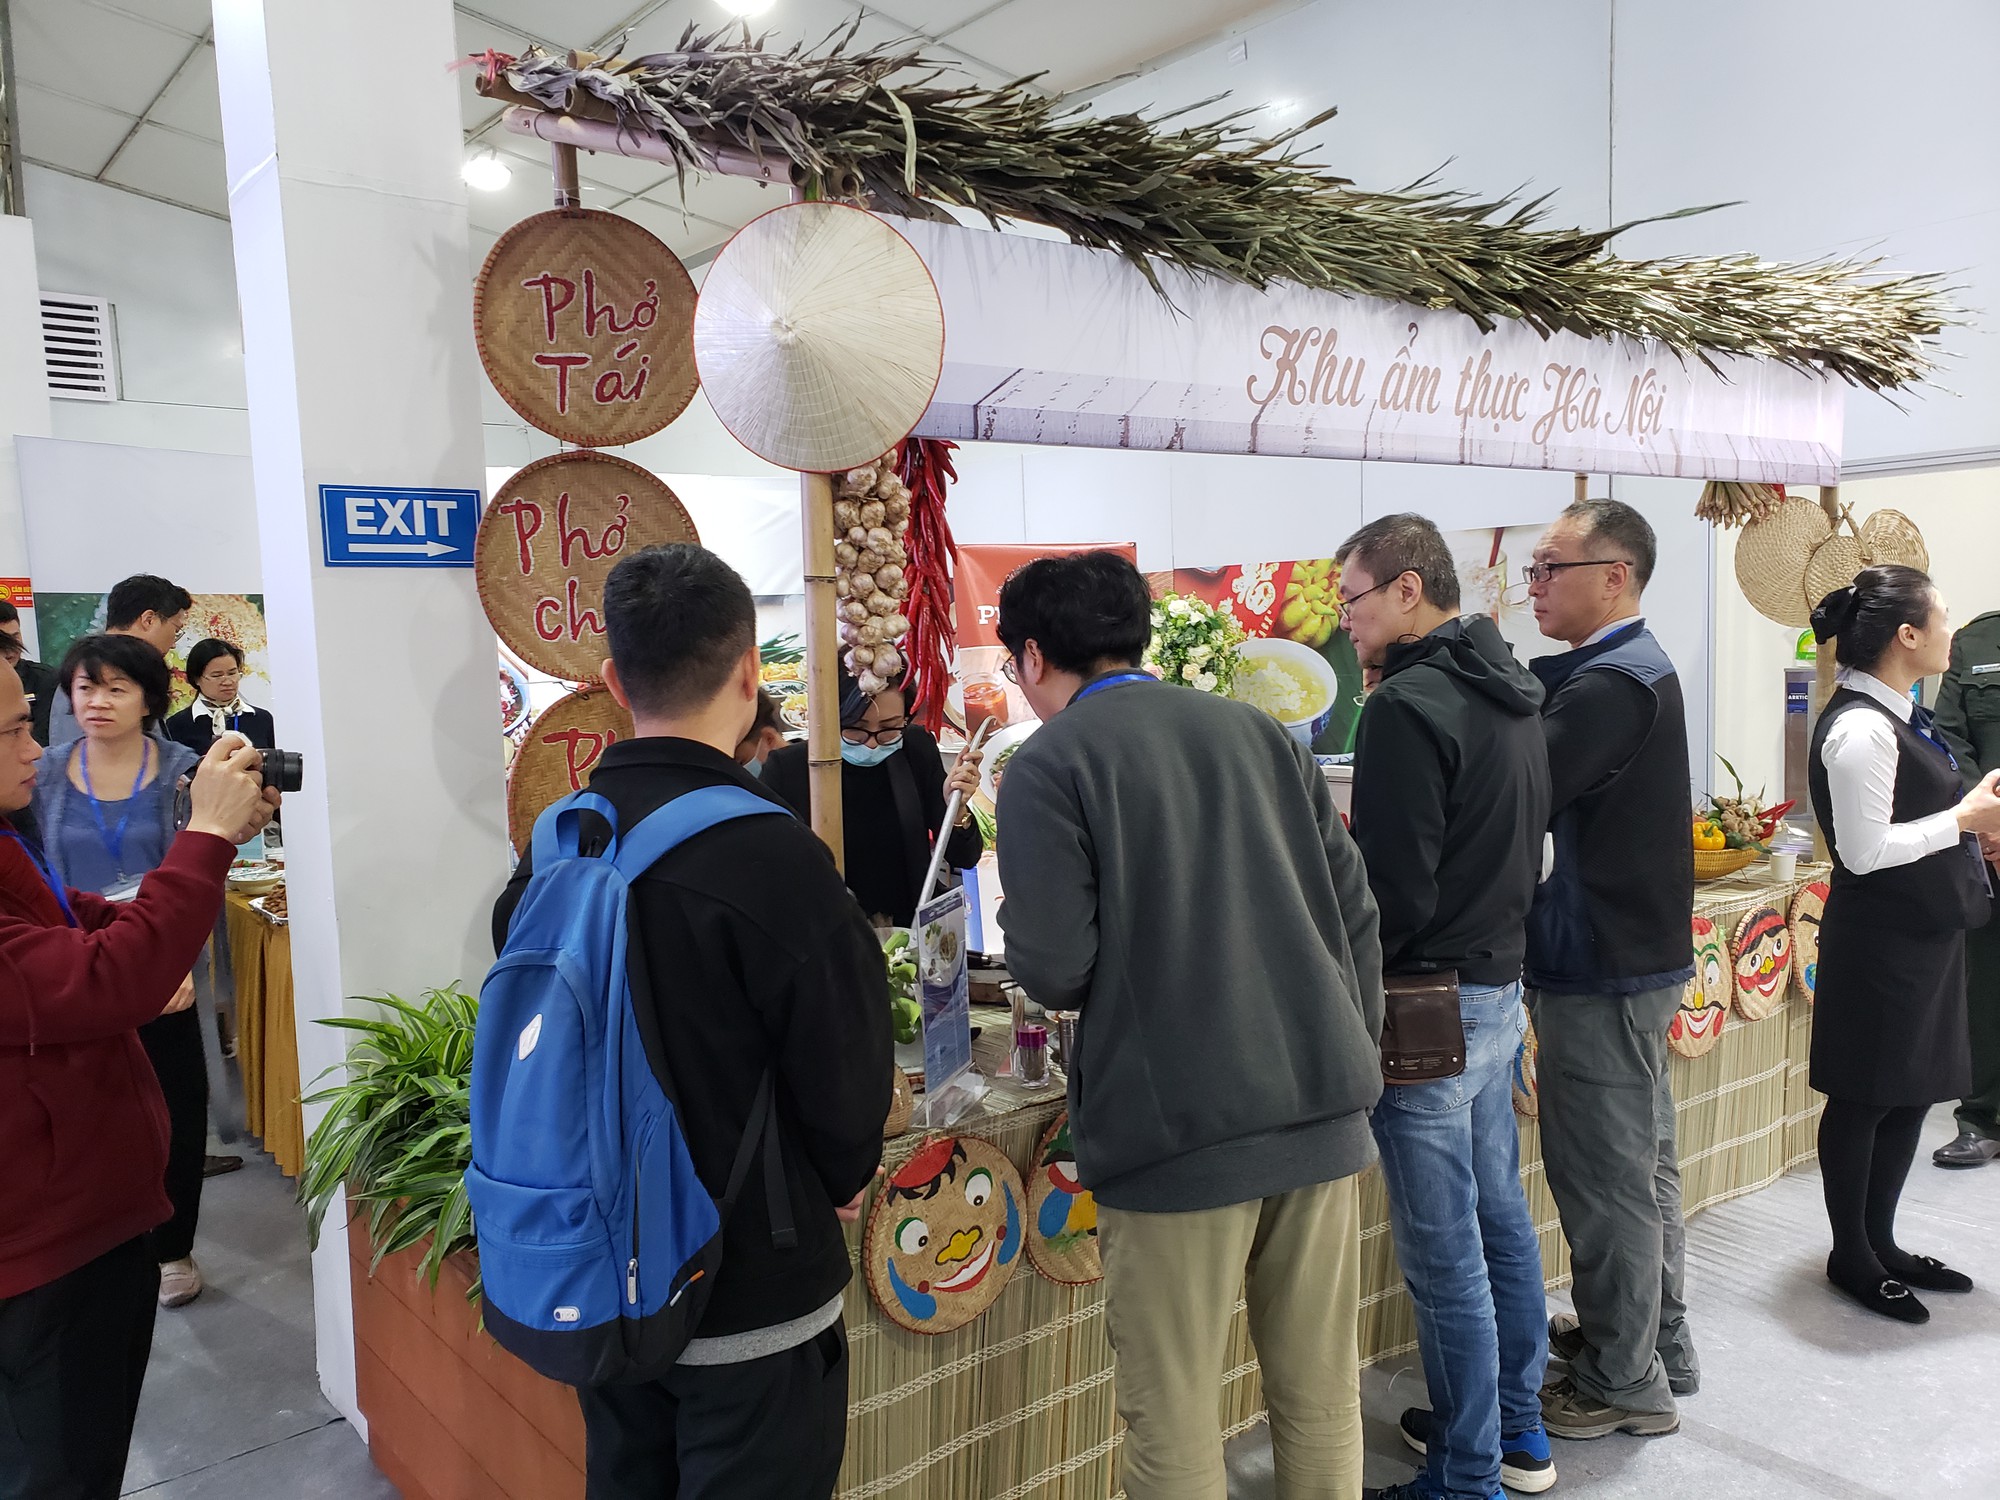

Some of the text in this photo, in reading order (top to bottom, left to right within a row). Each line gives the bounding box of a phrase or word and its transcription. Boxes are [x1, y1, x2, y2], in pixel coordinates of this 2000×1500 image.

[521, 269, 660, 343] Phở
[532, 339, 651, 415] Tái
[1246, 321, 1668, 447] Khu ẩm thực Hà Nội
[344, 496, 459, 537] EXIT
[499, 491, 632, 576] Phở
[534, 575, 608, 643] ch
[541, 726, 617, 792] P
